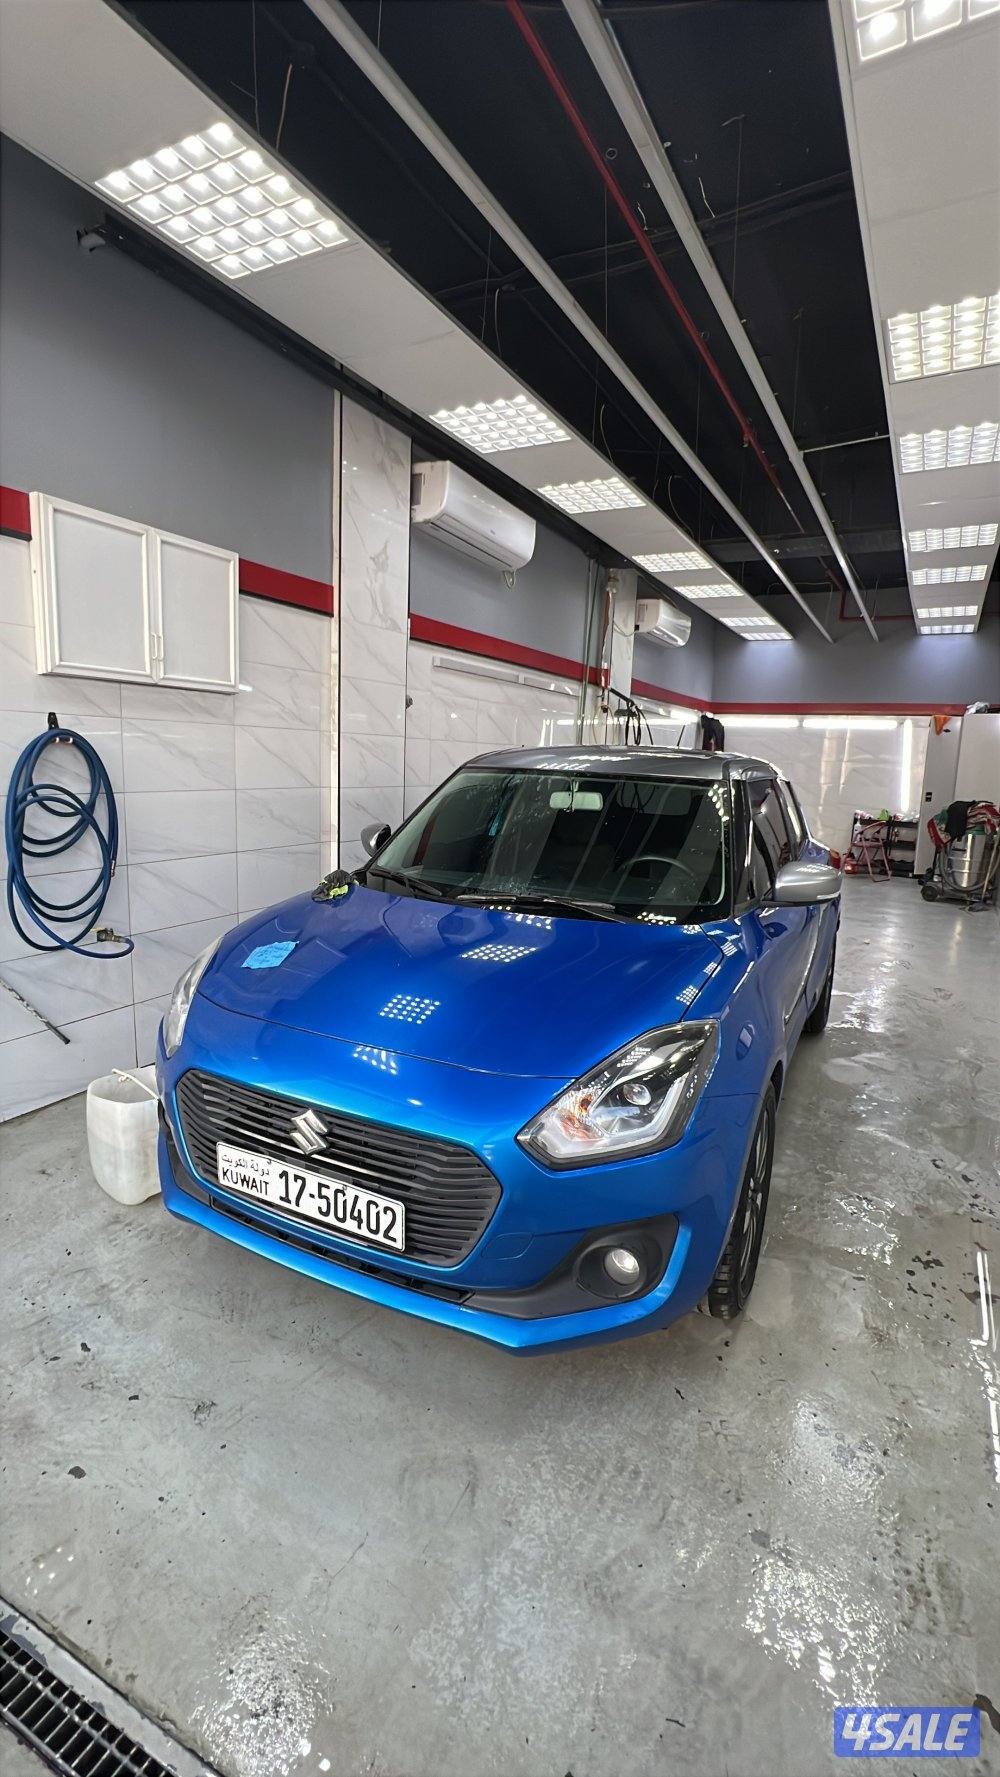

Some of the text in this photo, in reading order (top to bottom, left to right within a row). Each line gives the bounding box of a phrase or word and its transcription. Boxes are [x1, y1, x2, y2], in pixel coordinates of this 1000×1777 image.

[222, 1154, 270, 1177] دولة الكويت
[222, 1167, 270, 1196] KUWAIT
[278, 1170, 397, 1243] 17-50402
